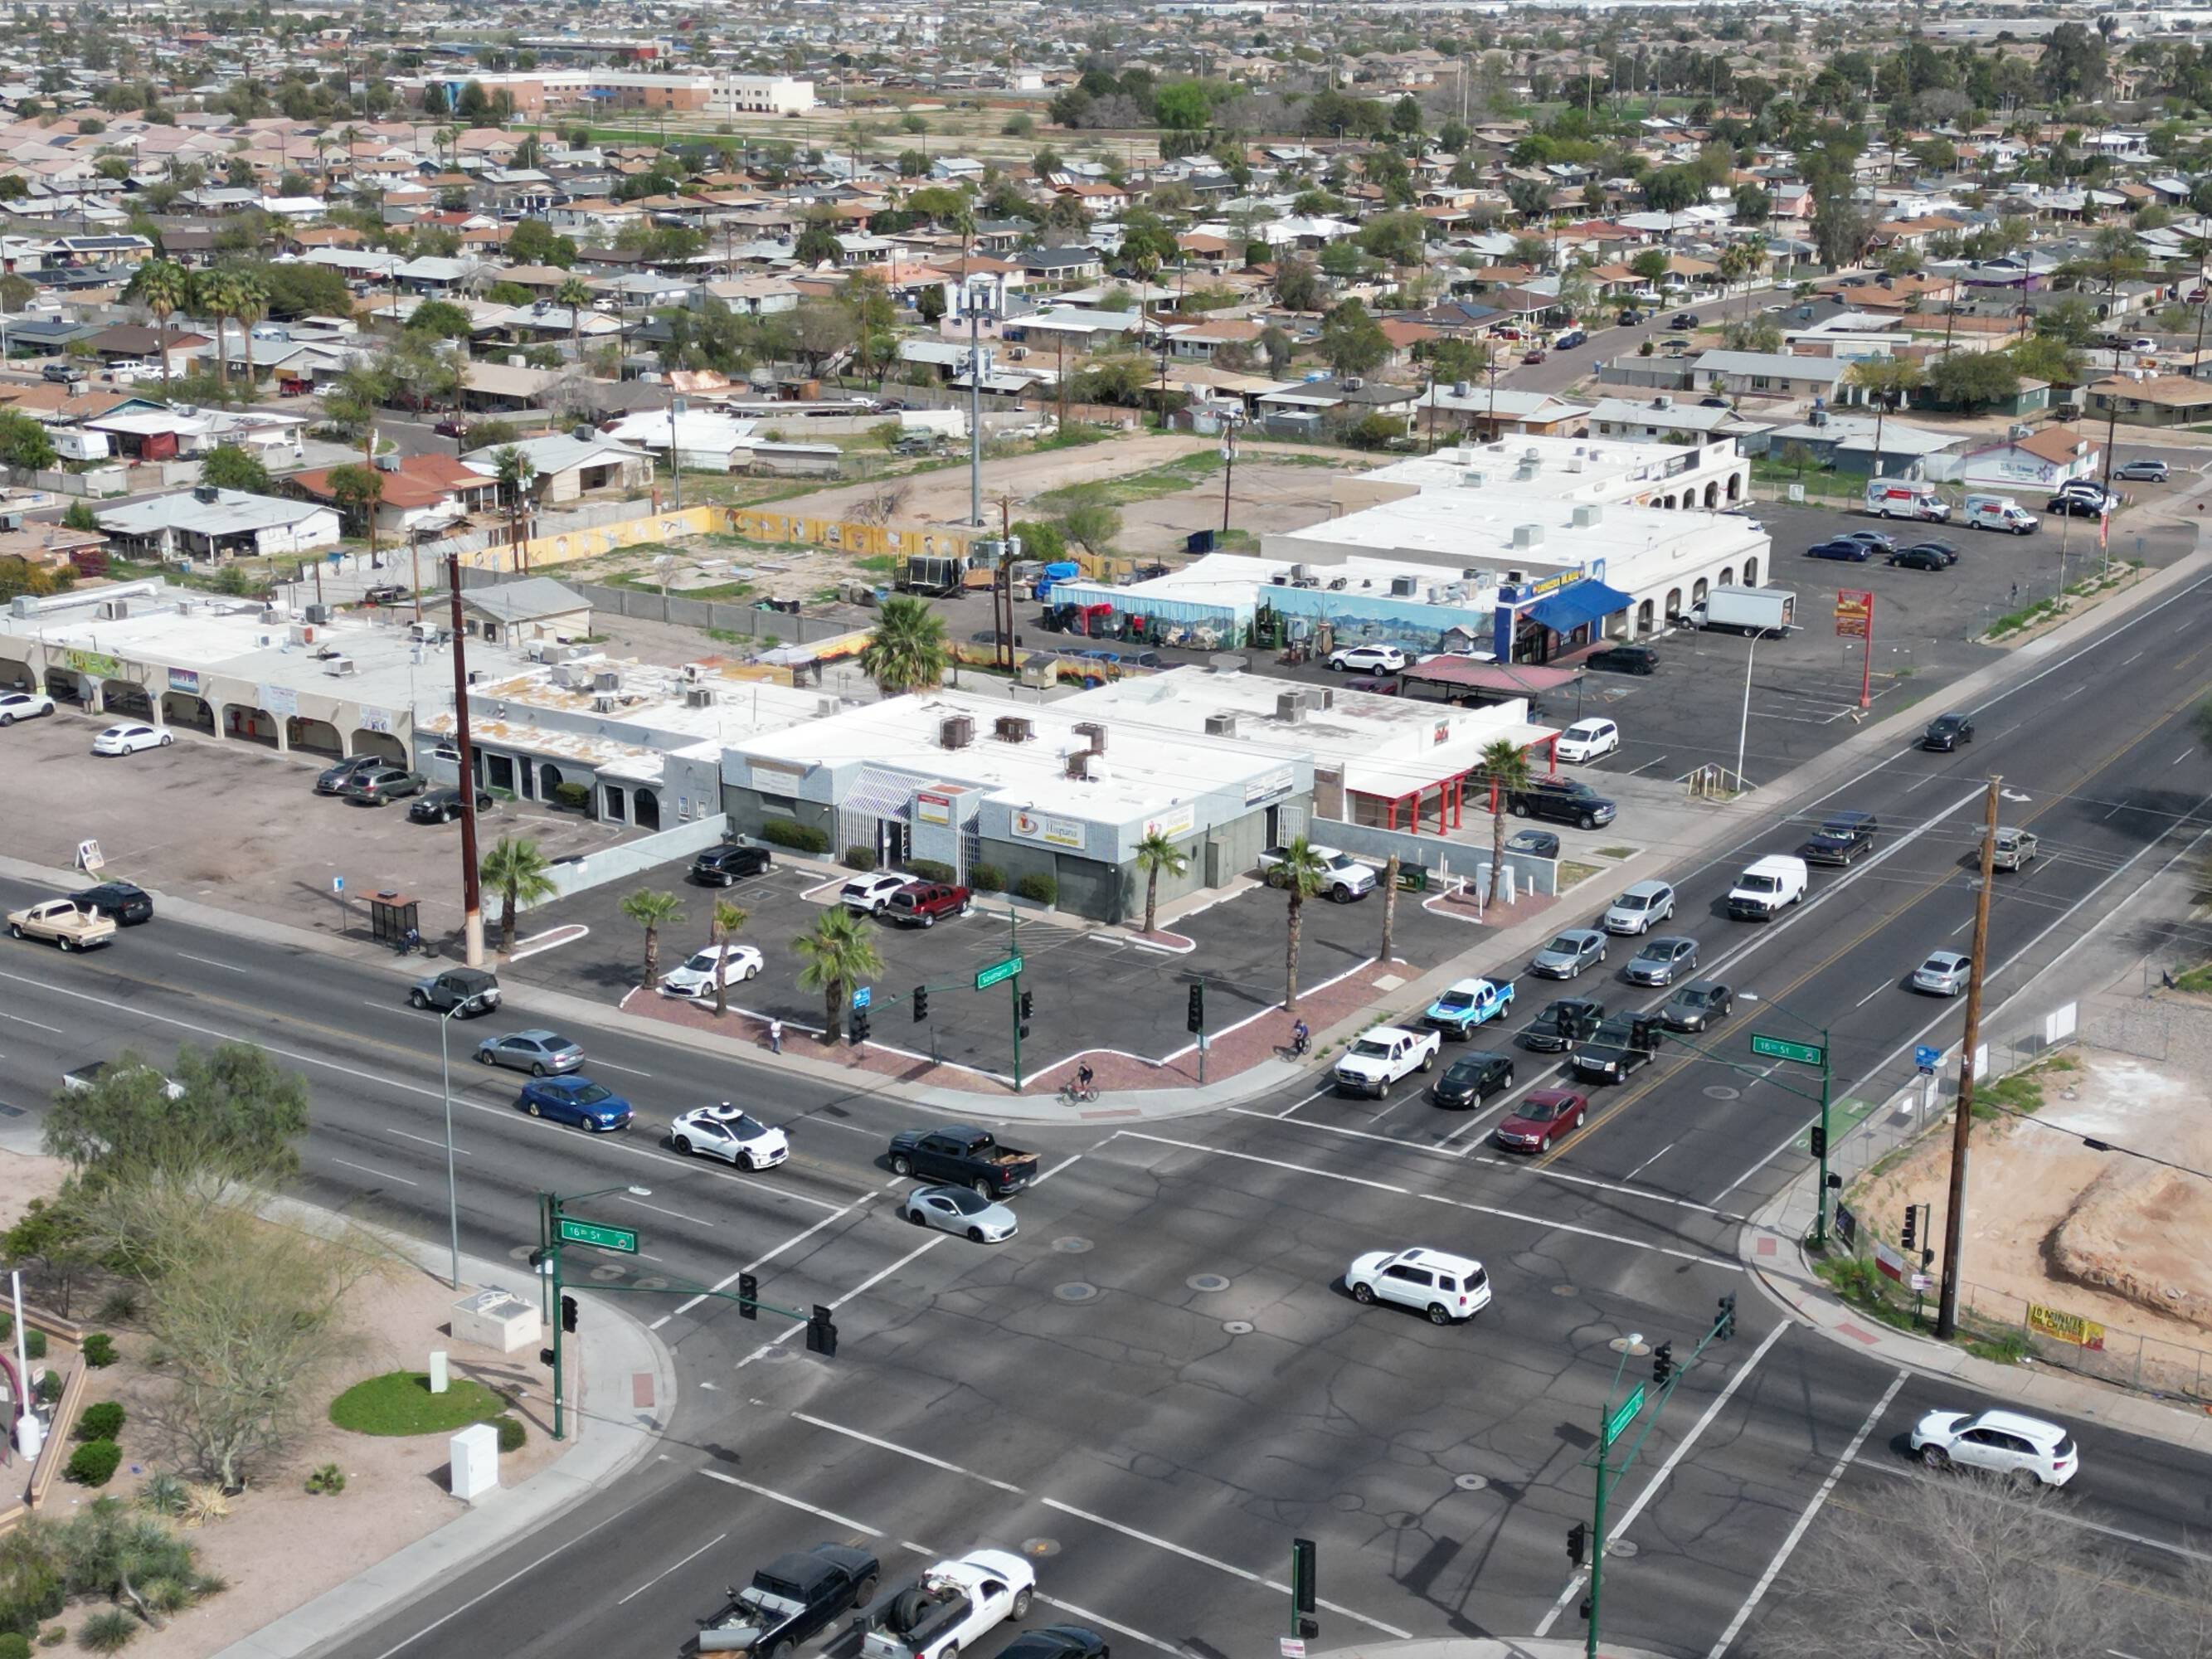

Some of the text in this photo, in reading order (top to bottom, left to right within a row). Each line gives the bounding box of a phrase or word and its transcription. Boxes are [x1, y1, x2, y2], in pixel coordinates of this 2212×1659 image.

[591, 1230, 601, 1241] St
[2033, 1306, 2084, 1328] 10 MINUTE
